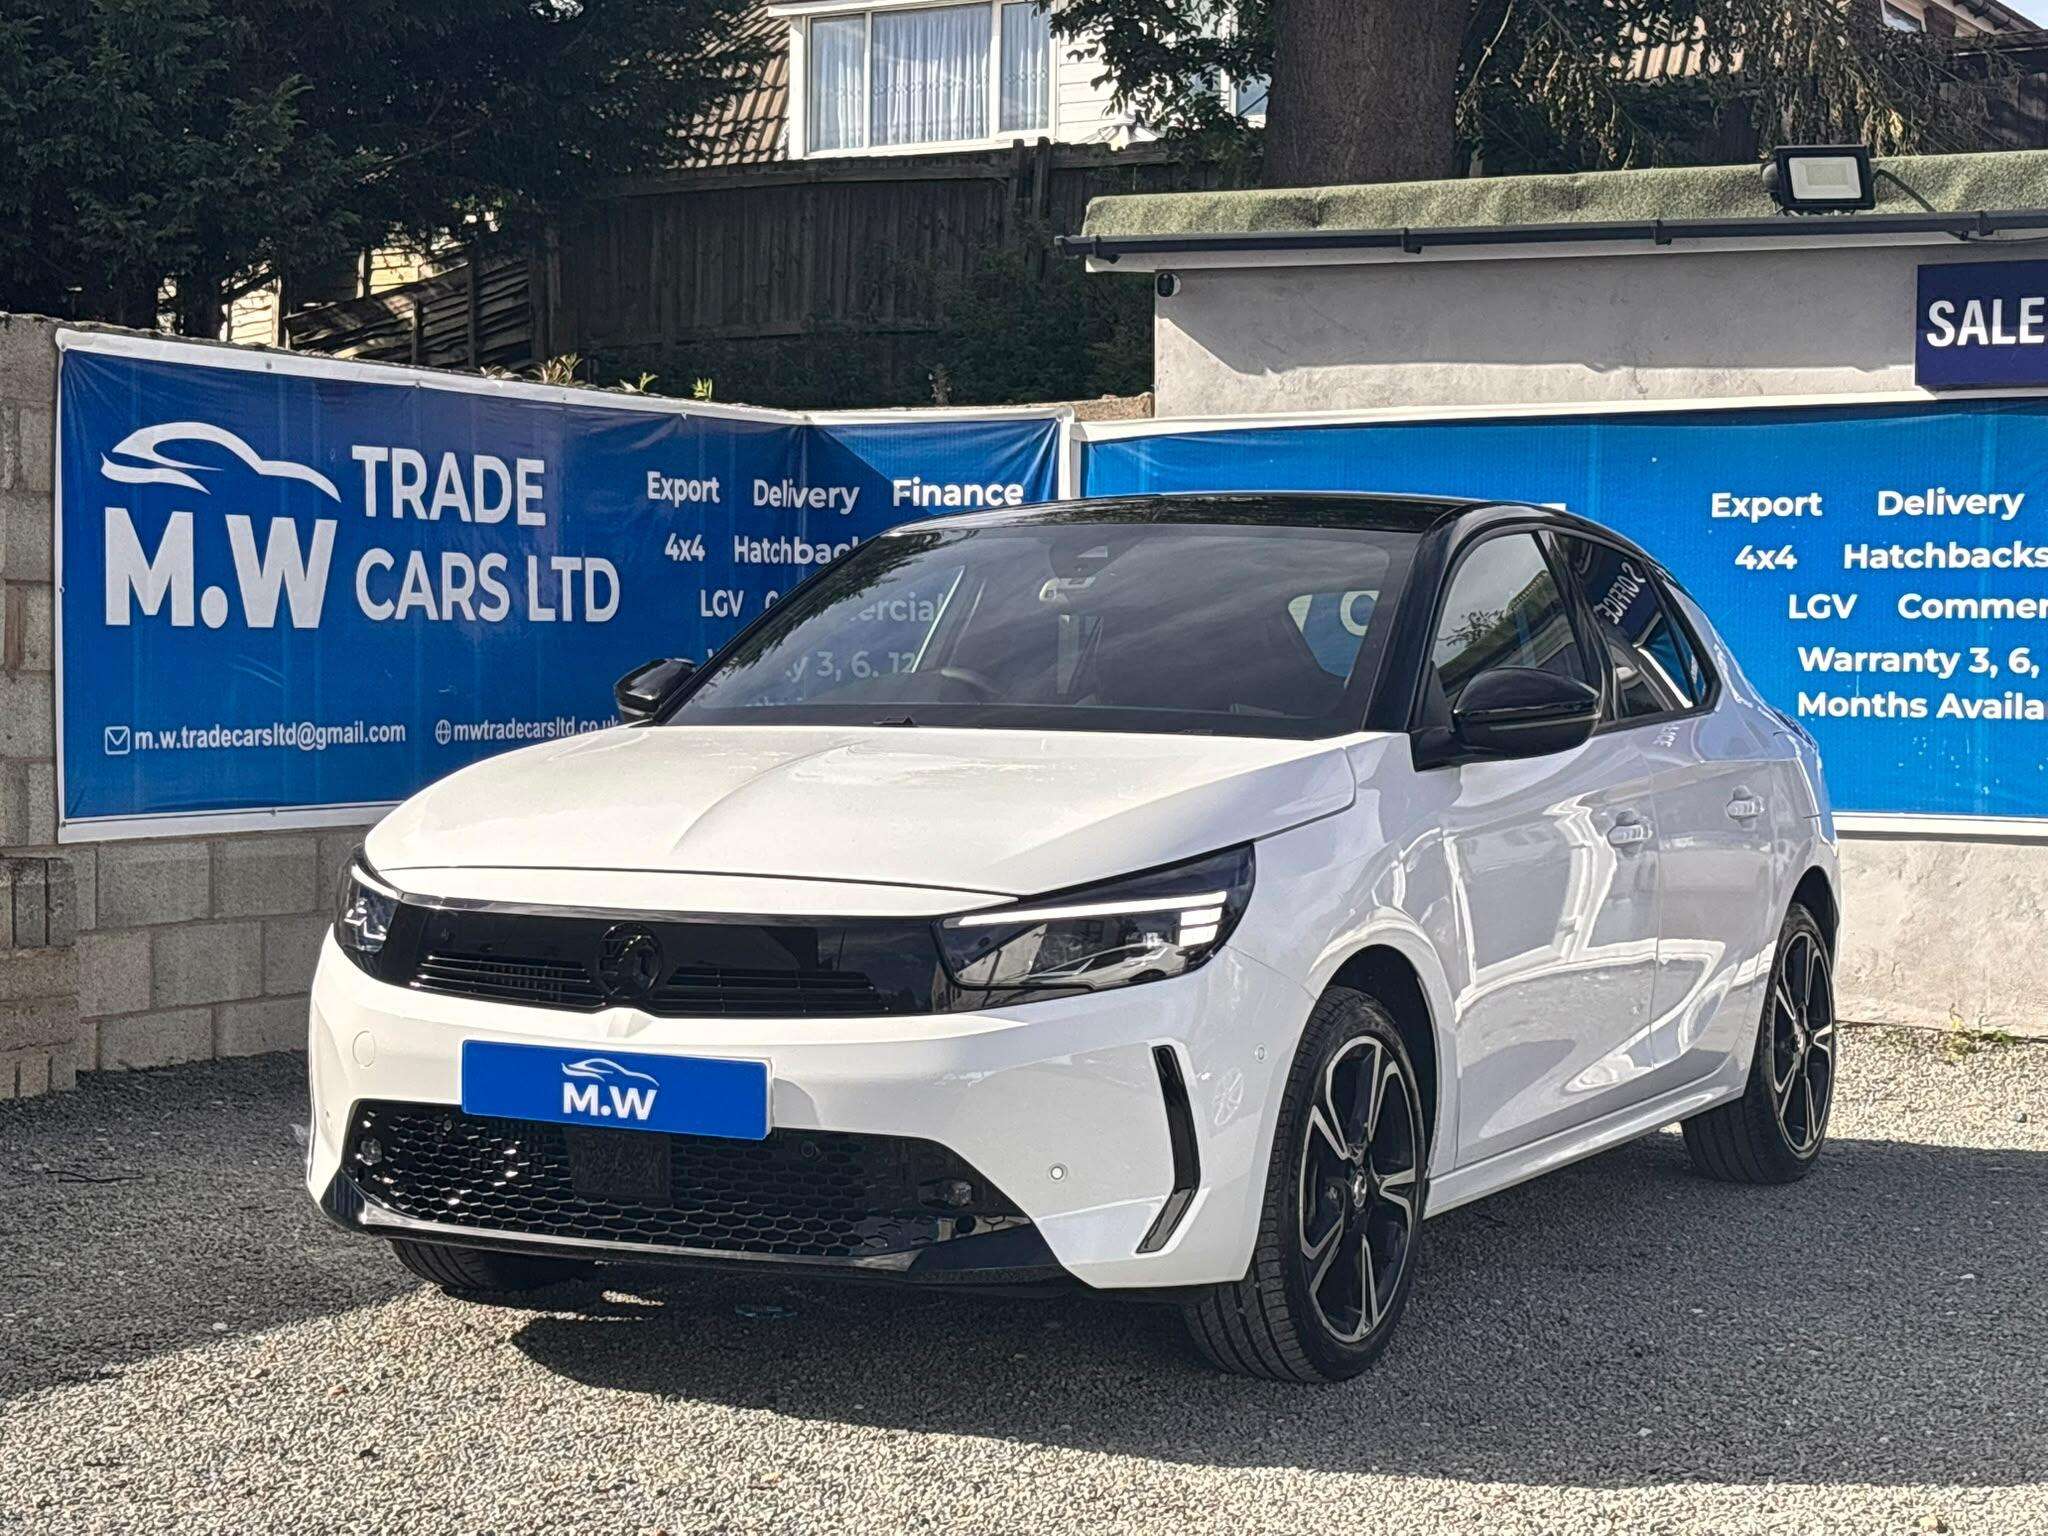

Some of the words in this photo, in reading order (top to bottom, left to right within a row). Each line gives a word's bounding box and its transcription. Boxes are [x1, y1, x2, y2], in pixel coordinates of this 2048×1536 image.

[1926, 297, 2045, 347] SALE
[351, 444, 547, 527] TRADE
[647, 470, 720, 507] Export
[753, 478, 860, 515] Delivery
[892, 476, 1025, 507] Finance
[1711, 492, 1823, 523] Export
[1877, 486, 2025, 521] Delivery
[664, 532, 706, 563] 4x4
[1734, 544, 1798, 571] 4x4
[1843, 540, 2048, 569] Hatchbacks
[104, 506, 338, 629] M.W
[355, 547, 511, 622] CARS
[527, 554, 620, 623] LTD
[700, 588, 745, 619] LGV
[1788, 593, 1858, 620] LGV
[1797, 646, 1961, 680] Warranty
[1967, 646, 1999, 680] 3,
[2007, 646, 2041, 680] 6,
[1797, 691, 1928, 719] Months
[1935, 690, 2045, 720] Availa
[134, 720, 406, 751] m.w.tradecarsltd@gmail.com
[563, 1081, 658, 1121] M.W
